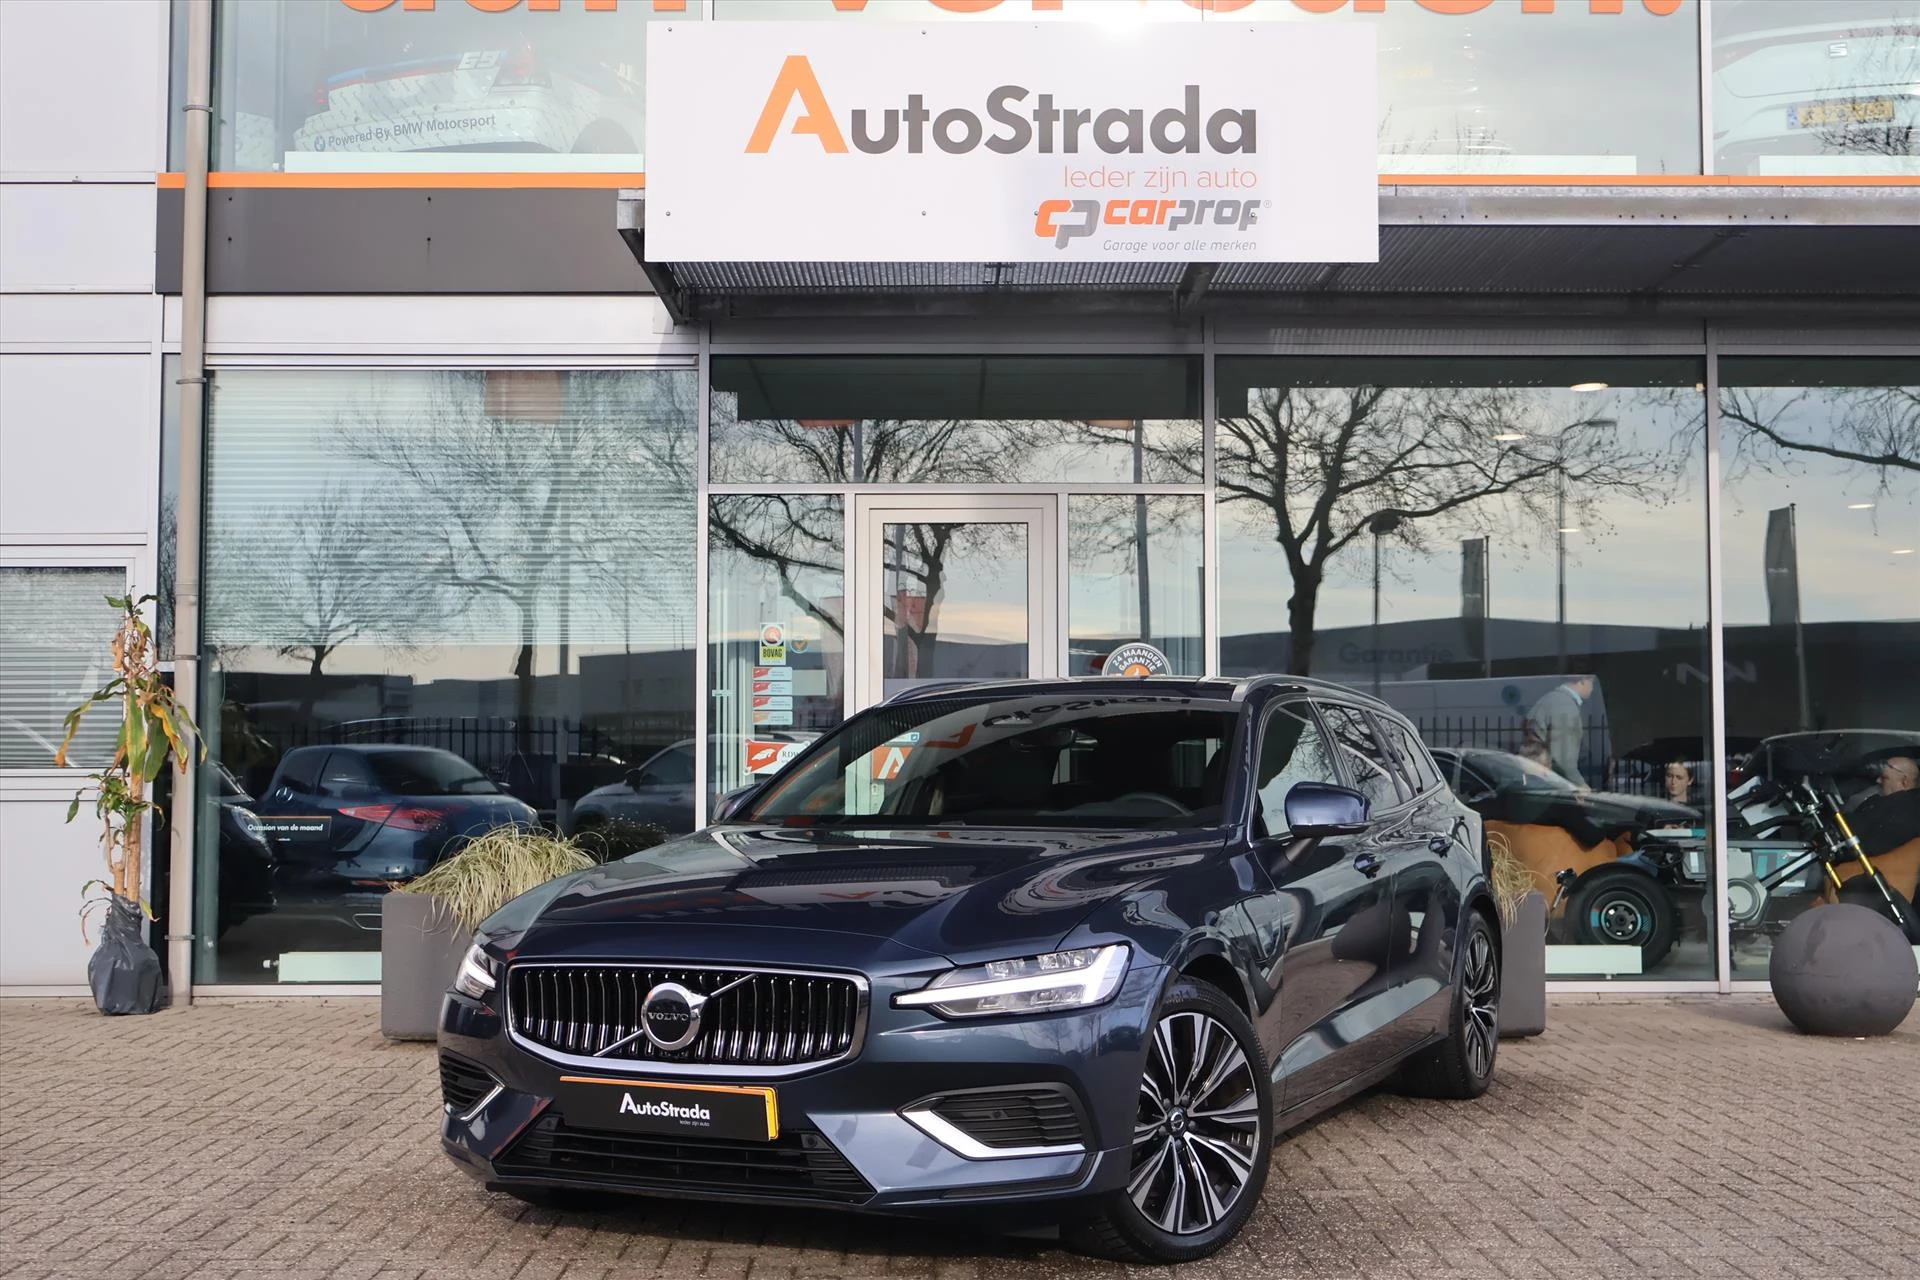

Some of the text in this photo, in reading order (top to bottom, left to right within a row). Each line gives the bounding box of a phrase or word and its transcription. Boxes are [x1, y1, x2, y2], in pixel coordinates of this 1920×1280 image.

[744, 55, 1257, 154] AutoStrada
[328, 114, 497, 147] Powered By BMW Motorsport
[1144, 165, 1188, 194] zijn
[1197, 167, 1257, 188] auto
[1103, 239, 1257, 253] Garage voor alle merken
[762, 648, 782, 658] BOVAG
[1112, 648, 1163, 668] 24 MAANDEN
[1118, 656, 1157, 672] GARANTIE
[290, 823, 299, 831] de
[300, 823, 324, 831] maand
[648, 1012, 689, 1021] VOLVO
[619, 1092, 710, 1120] AutoStrada
